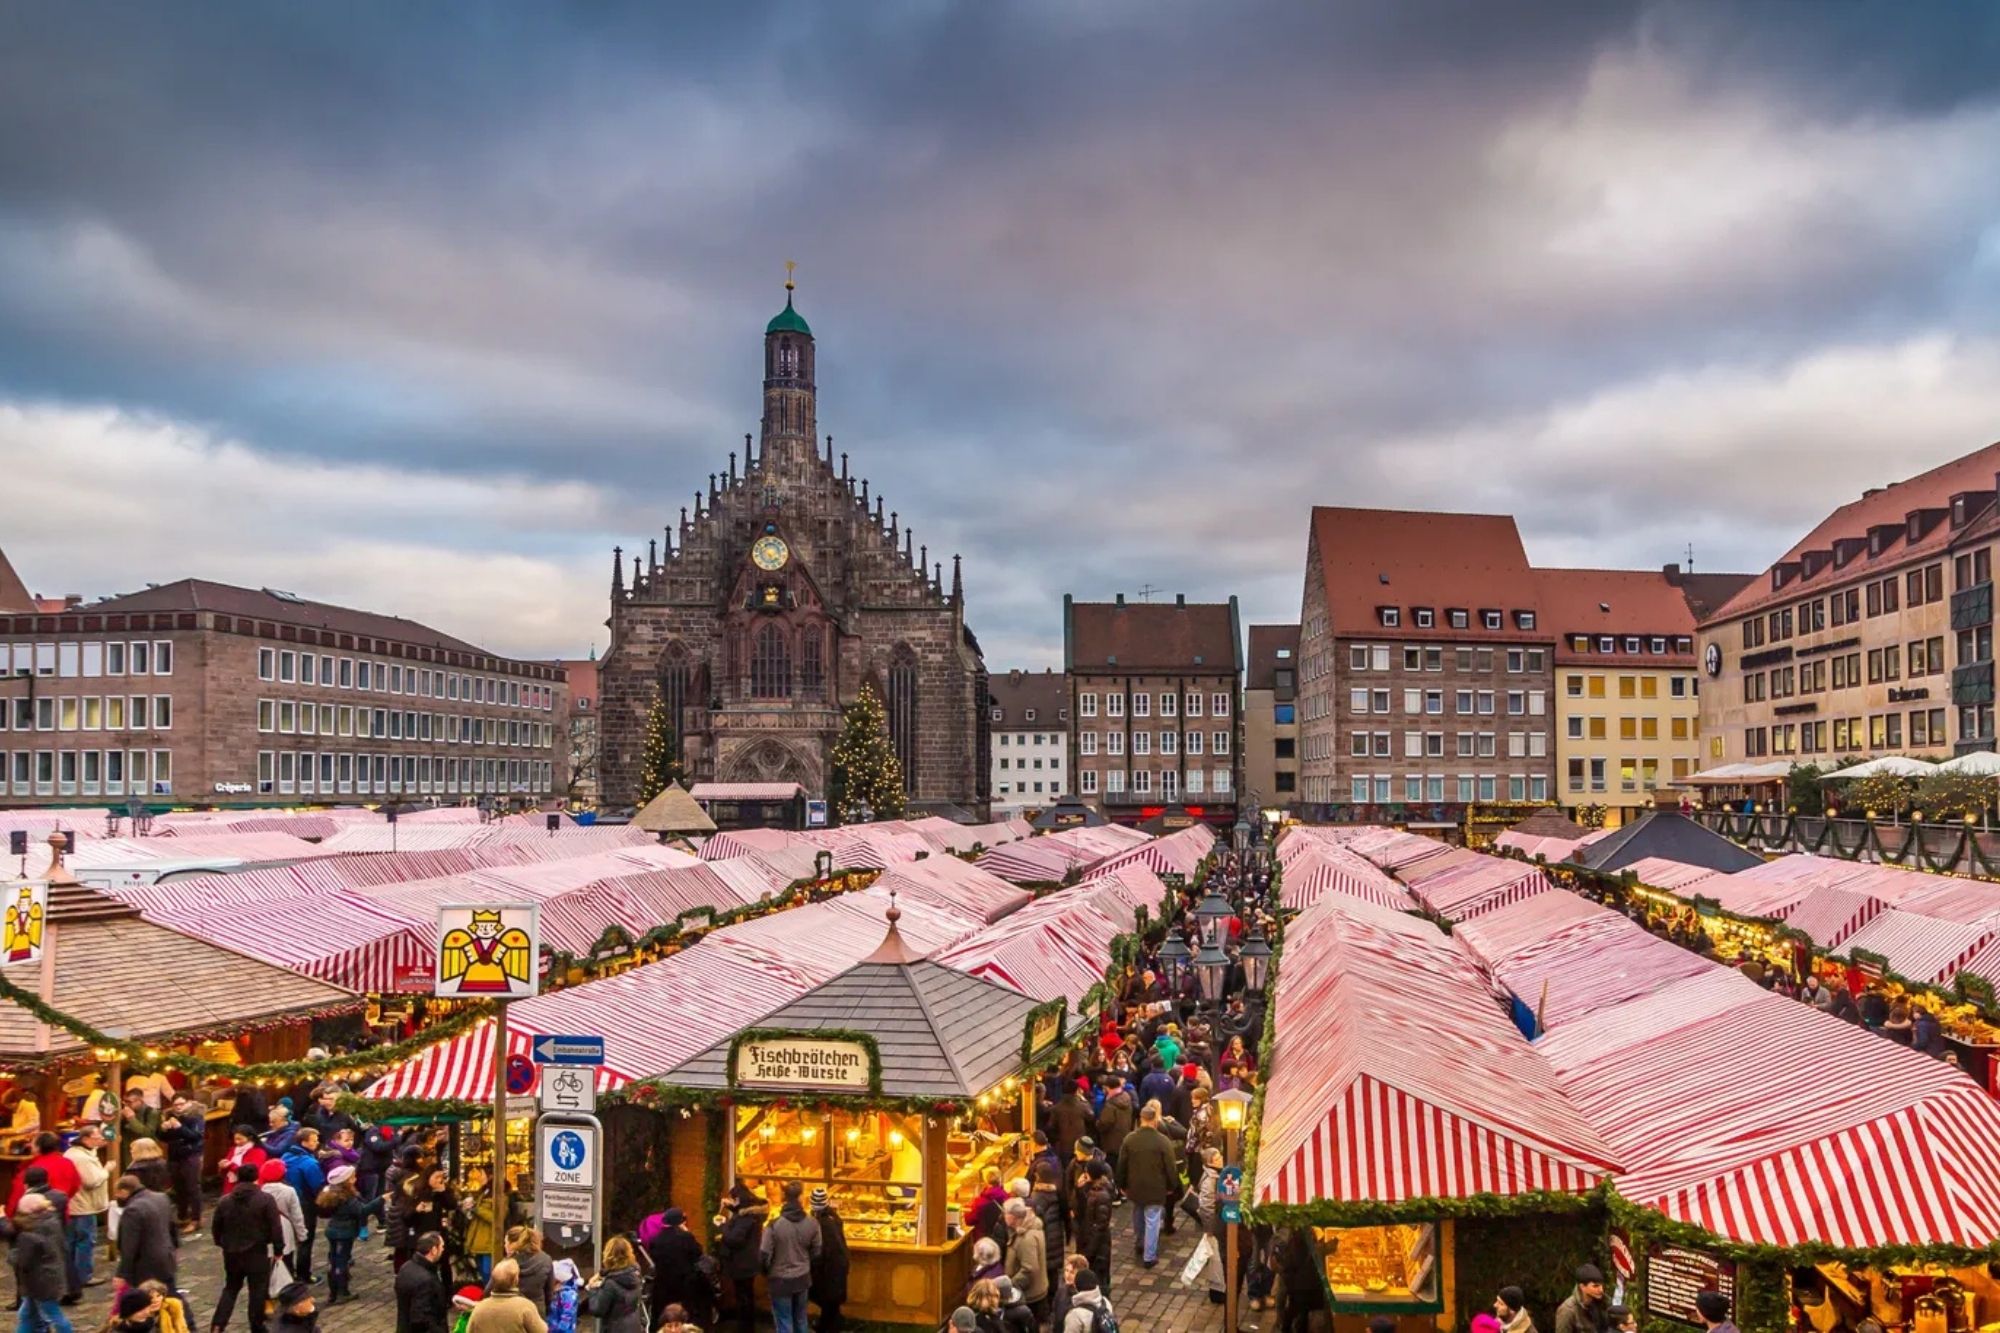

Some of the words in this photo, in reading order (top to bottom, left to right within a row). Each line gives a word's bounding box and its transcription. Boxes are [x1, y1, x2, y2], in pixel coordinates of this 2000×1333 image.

[214, 782, 252, 794] Crêperie
[749, 1046, 859, 1067] Fischbrötchen
[798, 1065, 848, 1080] Würste
[554, 1172, 581, 1183] ZONE
